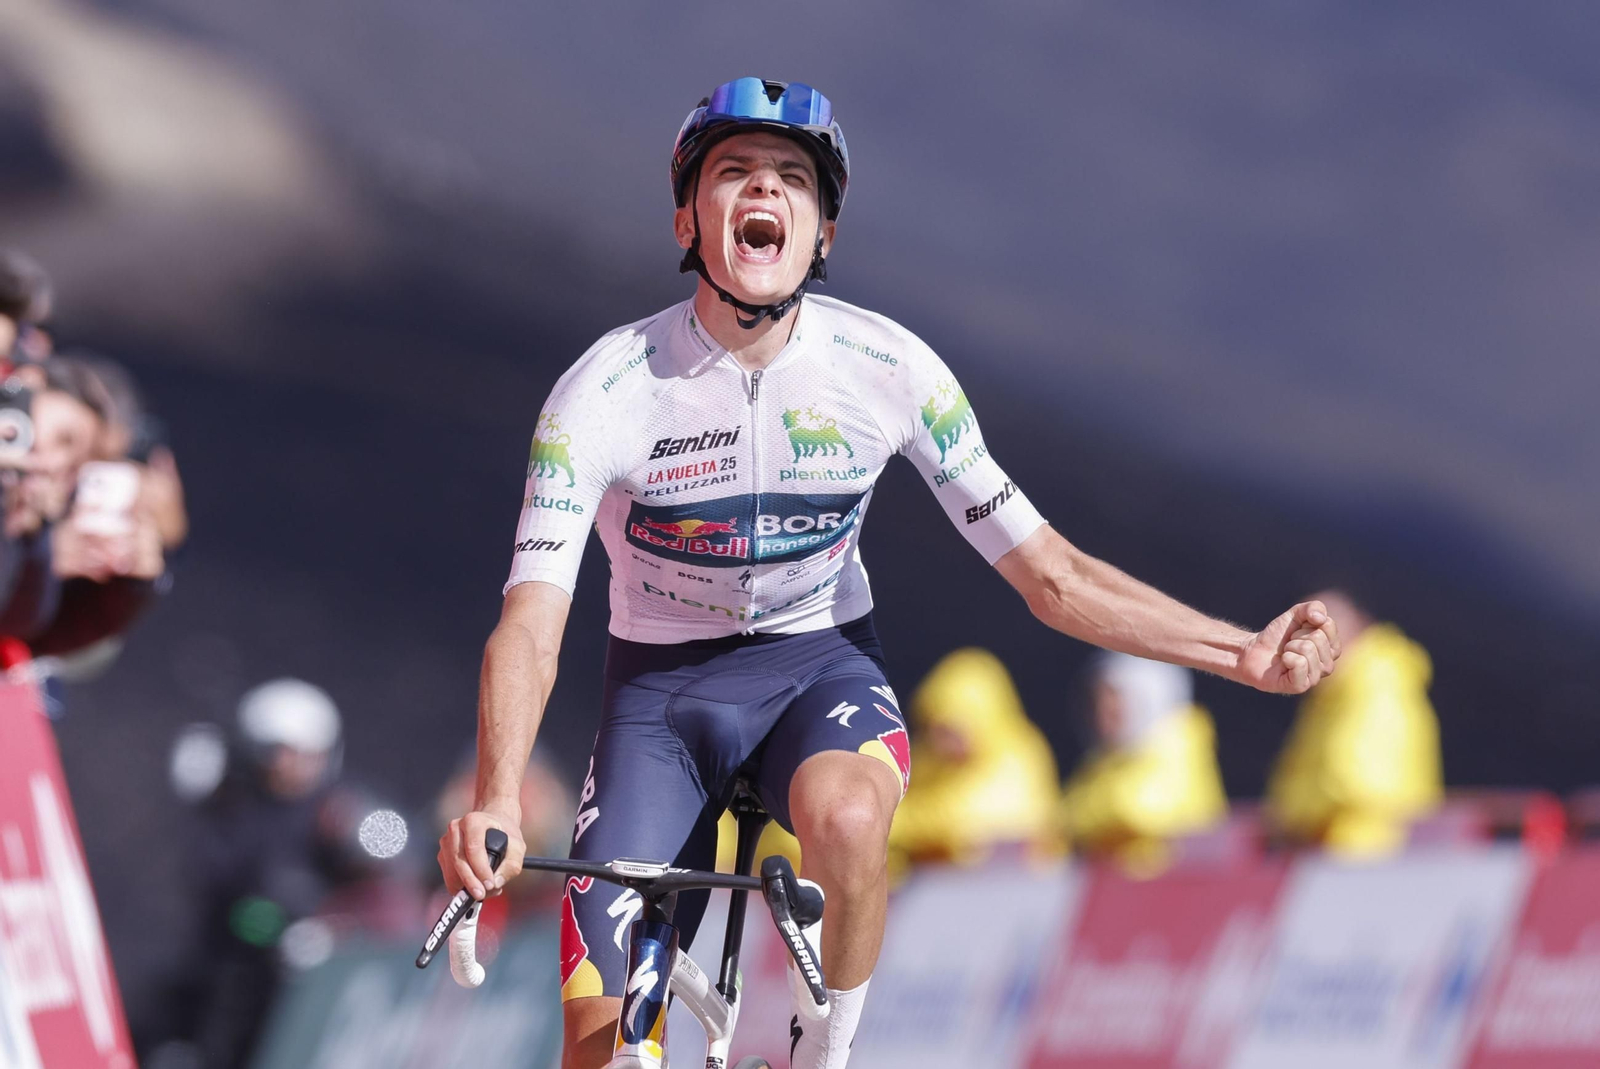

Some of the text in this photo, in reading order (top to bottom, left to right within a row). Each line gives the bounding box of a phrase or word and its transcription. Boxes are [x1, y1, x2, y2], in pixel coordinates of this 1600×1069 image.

[834, 334, 898, 366] plenitude
[601, 345, 657, 392] plenitude
[648, 425, 742, 461] Santini
[647, 456, 737, 485] LA VUELTA 25
[780, 466, 867, 483] plenitude
[933, 442, 987, 488] plenitu
[644, 473, 738, 498] PELLIZZARI
[515, 538, 568, 553] ntini
[630, 523, 749, 559] Red Bull
[678, 571, 713, 584] BOSS
[623, 866, 648, 874] GARMIN
[425, 889, 469, 951] SRAM
[781, 920, 822, 984] SRAM
